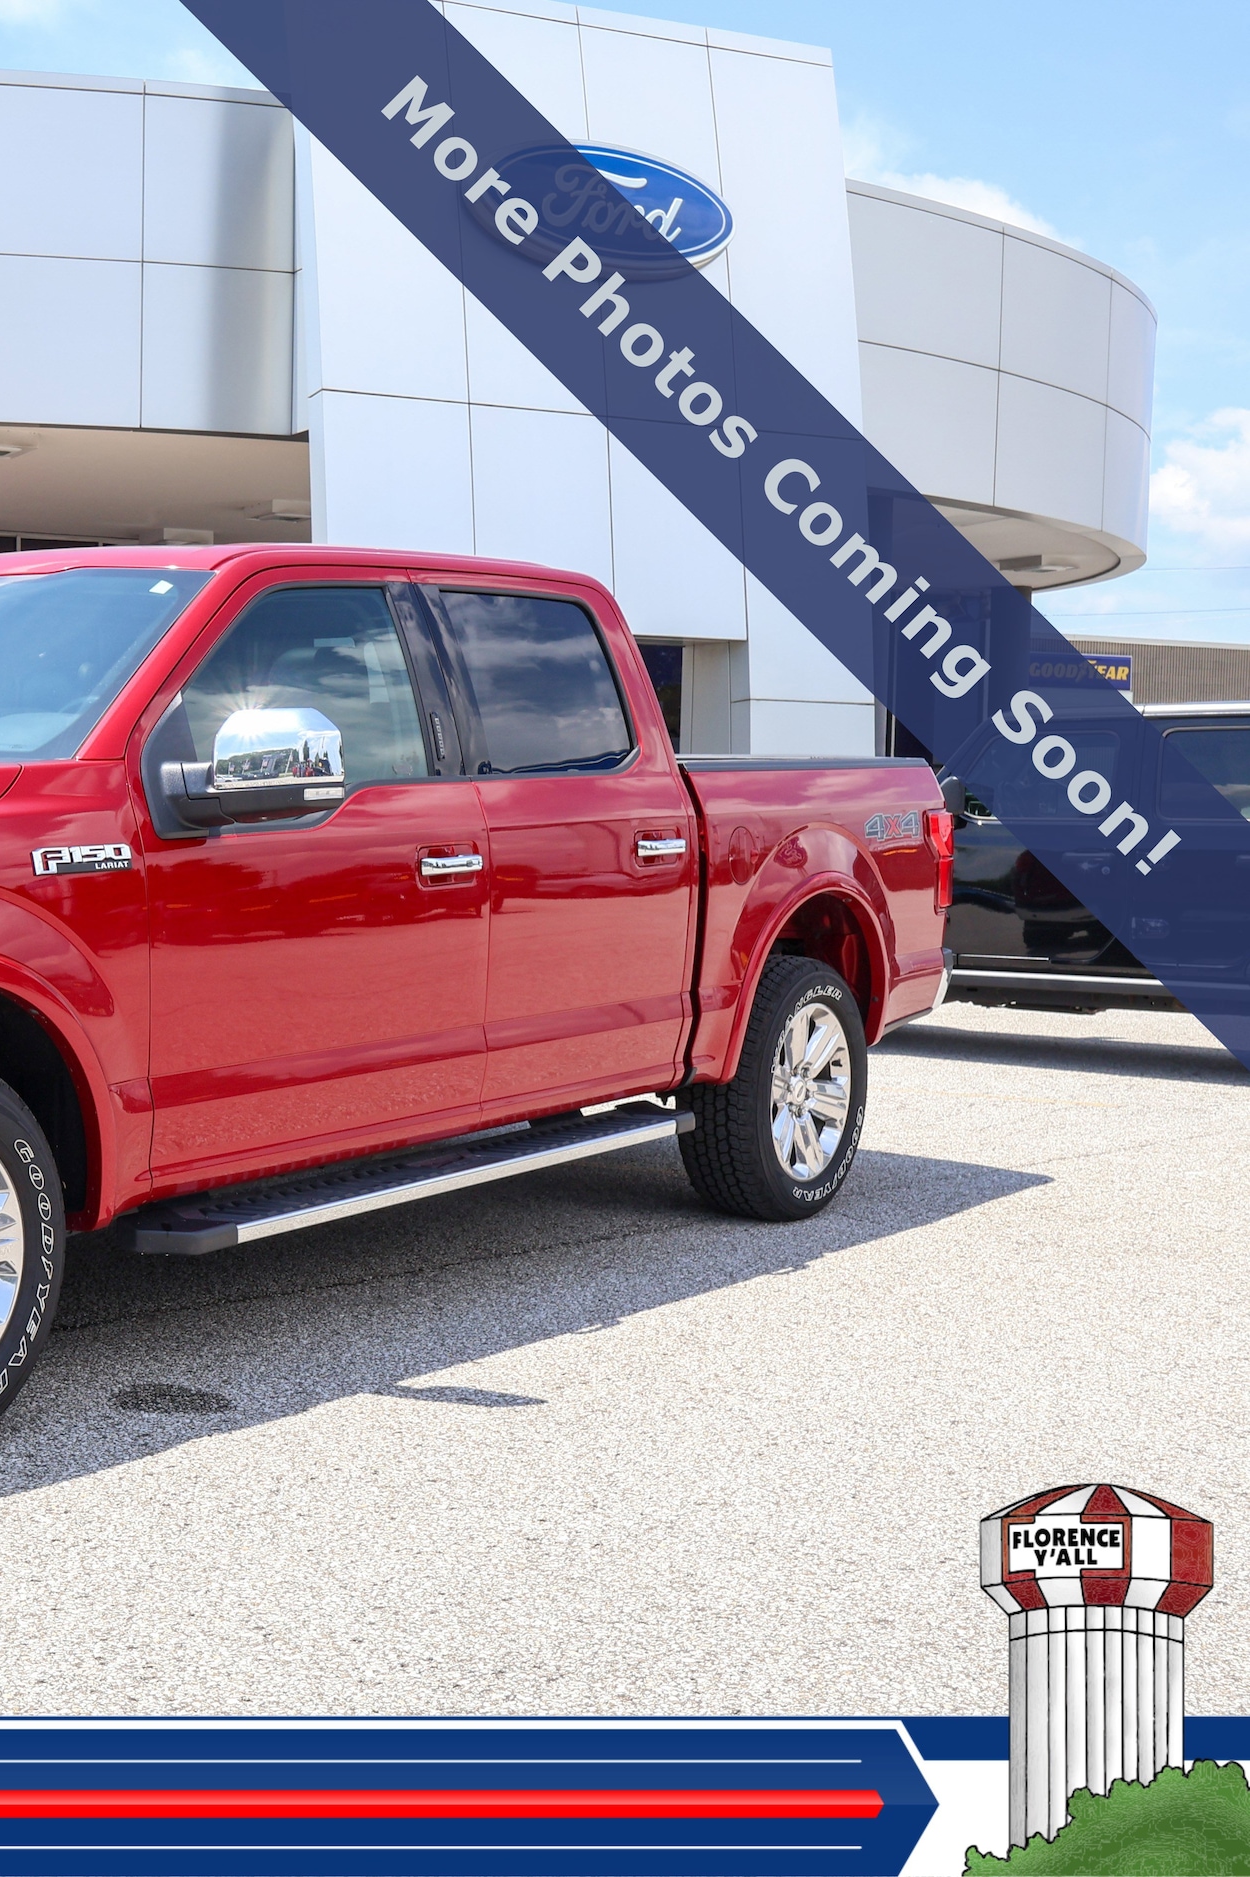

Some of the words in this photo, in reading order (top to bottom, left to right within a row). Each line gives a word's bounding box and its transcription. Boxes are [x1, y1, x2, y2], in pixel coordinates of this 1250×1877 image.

[541, 163, 684, 243] Ford
[94, 860, 129, 870] LARIAT
[792, 1105, 864, 1201] GOODYEAR
